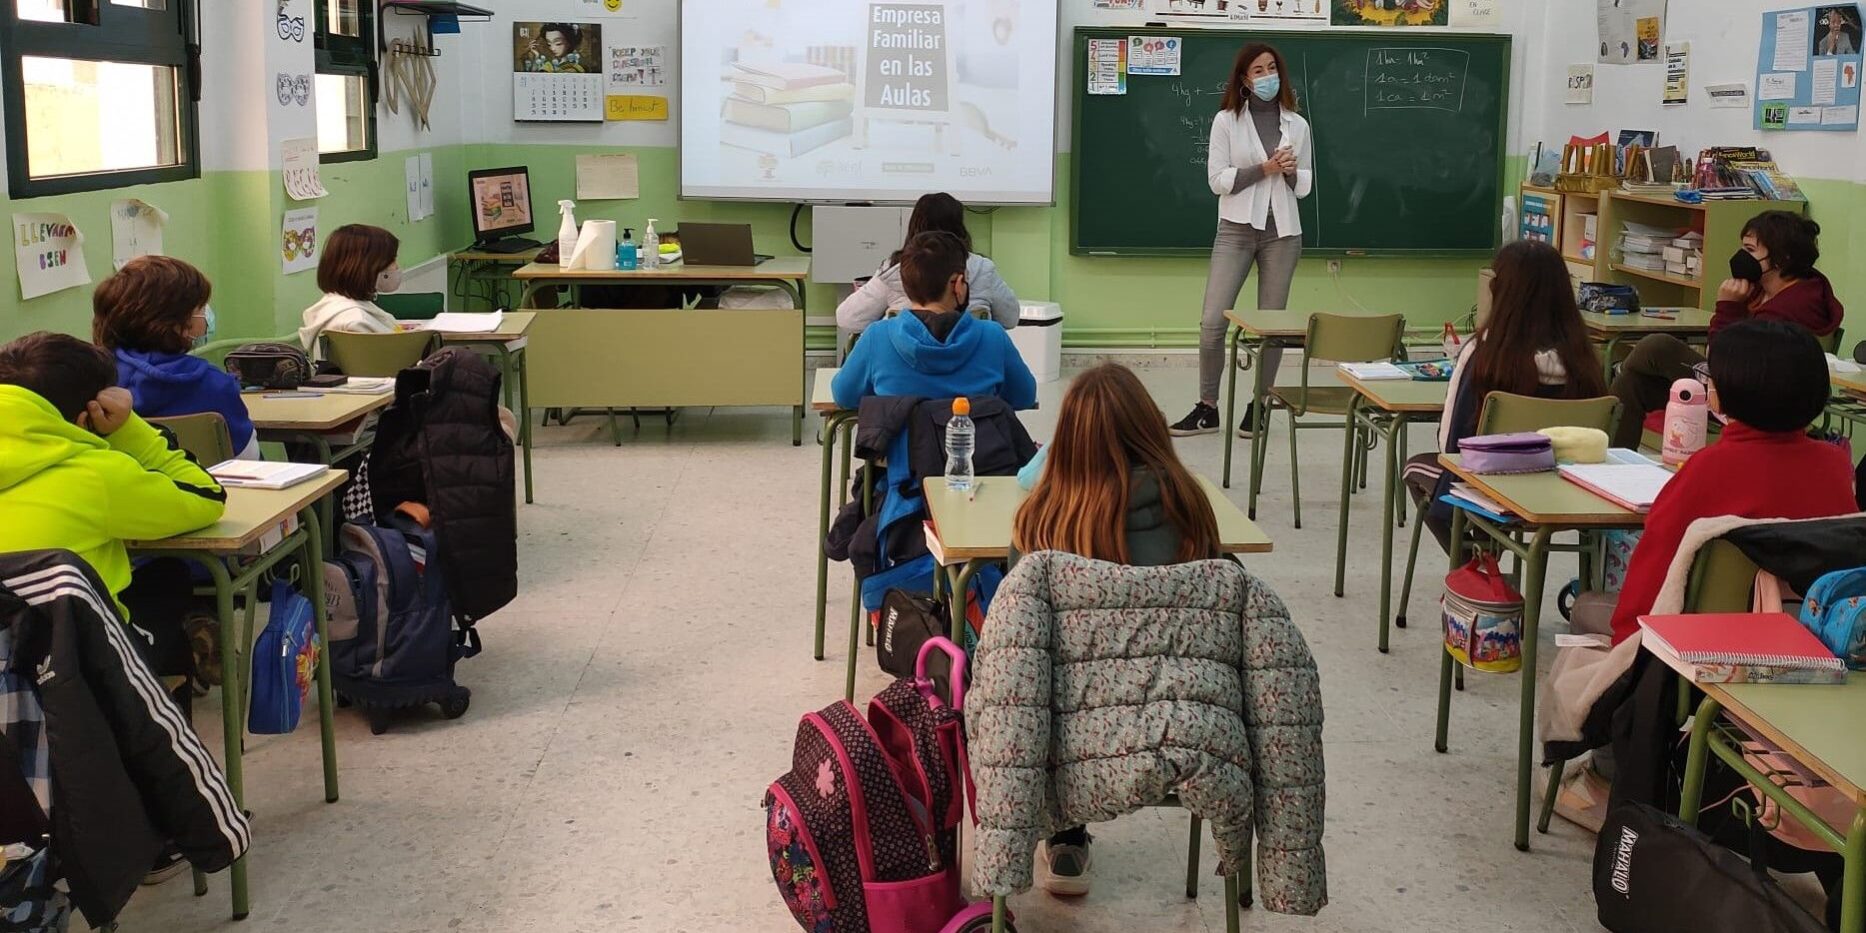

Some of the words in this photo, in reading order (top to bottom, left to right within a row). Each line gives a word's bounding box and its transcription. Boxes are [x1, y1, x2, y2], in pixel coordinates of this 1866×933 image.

[873, 6, 941, 27] Empresa
[873, 29, 941, 49] Familiar
[1090, 41, 1097, 49] 5
[880, 59, 901, 75] en
[908, 54, 932, 76] las
[1090, 72, 1096, 82] 2
[880, 82, 931, 106] Aulas
[610, 99, 624, 113] Be
[1611, 825, 1639, 894] MAHALO
